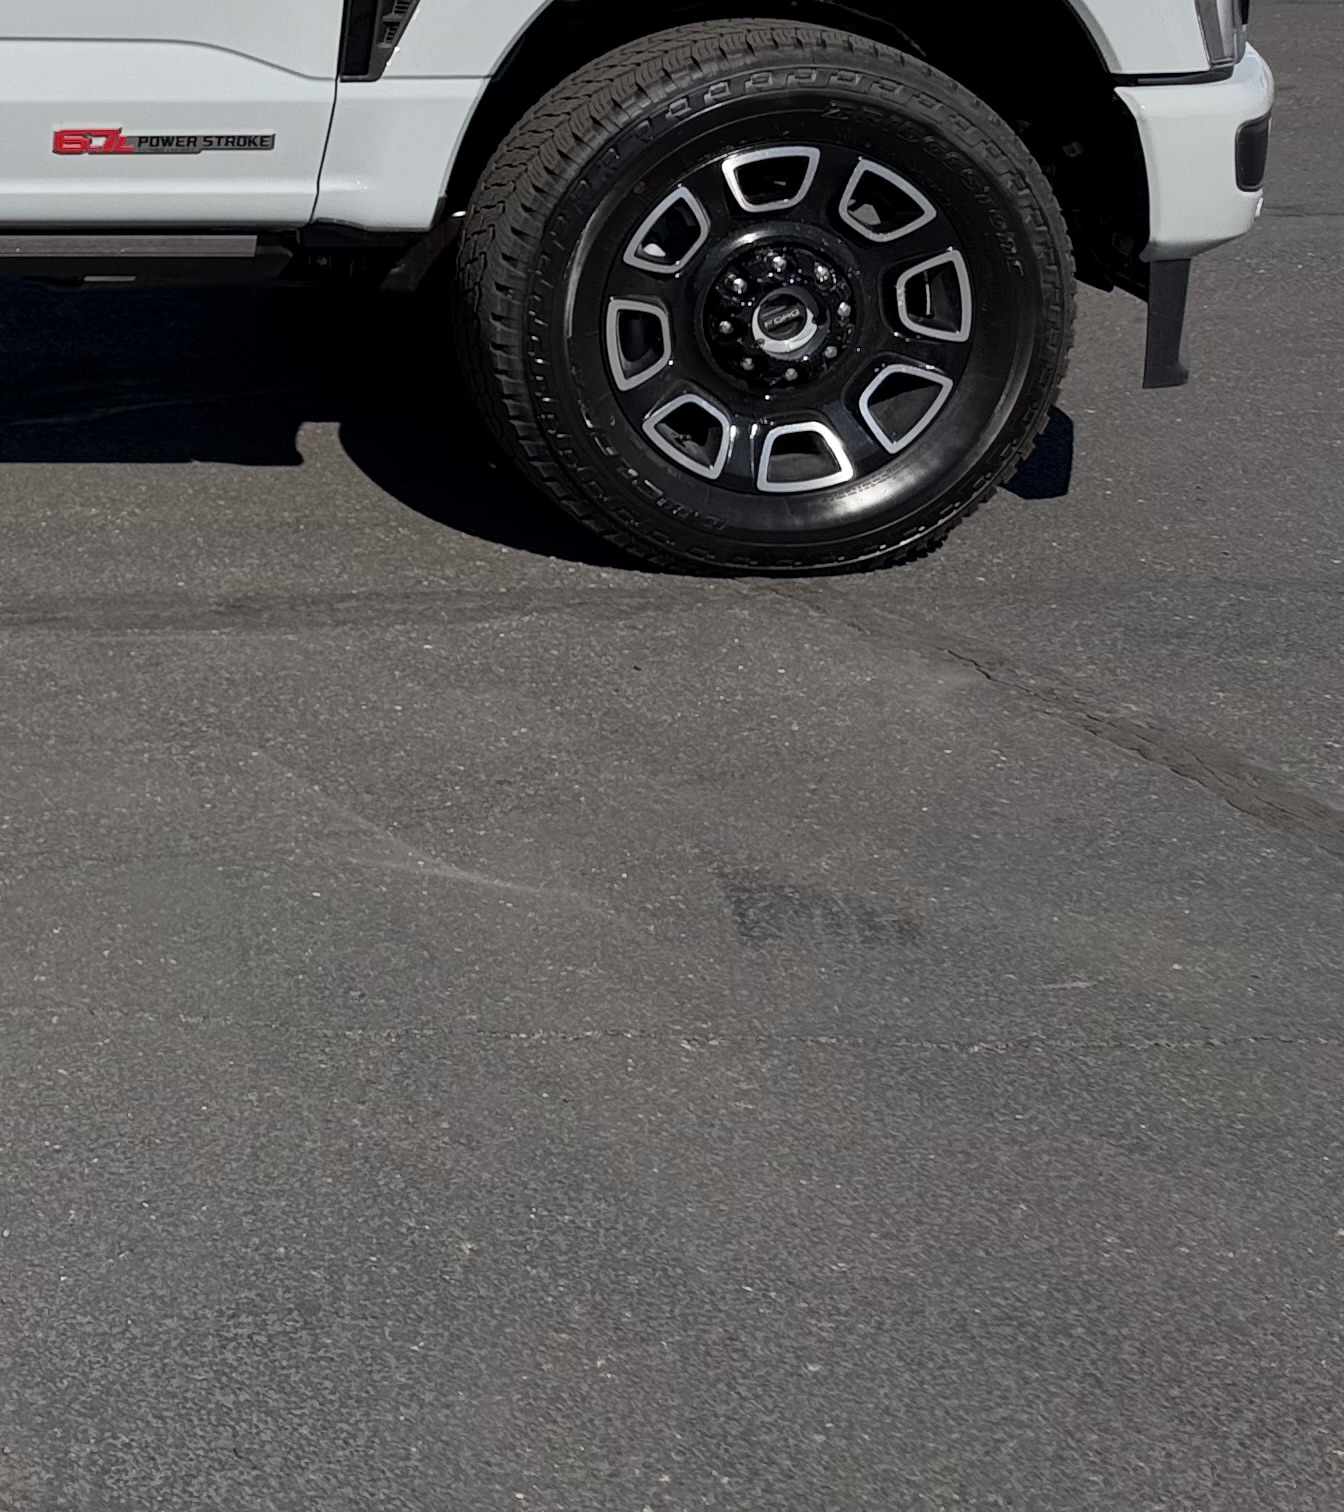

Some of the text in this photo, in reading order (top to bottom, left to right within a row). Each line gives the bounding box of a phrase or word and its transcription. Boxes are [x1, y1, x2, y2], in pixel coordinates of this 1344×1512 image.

[137, 136, 197, 148] POWER
[202, 135, 270, 148] STROKE
[764, 309, 800, 328] FORD
